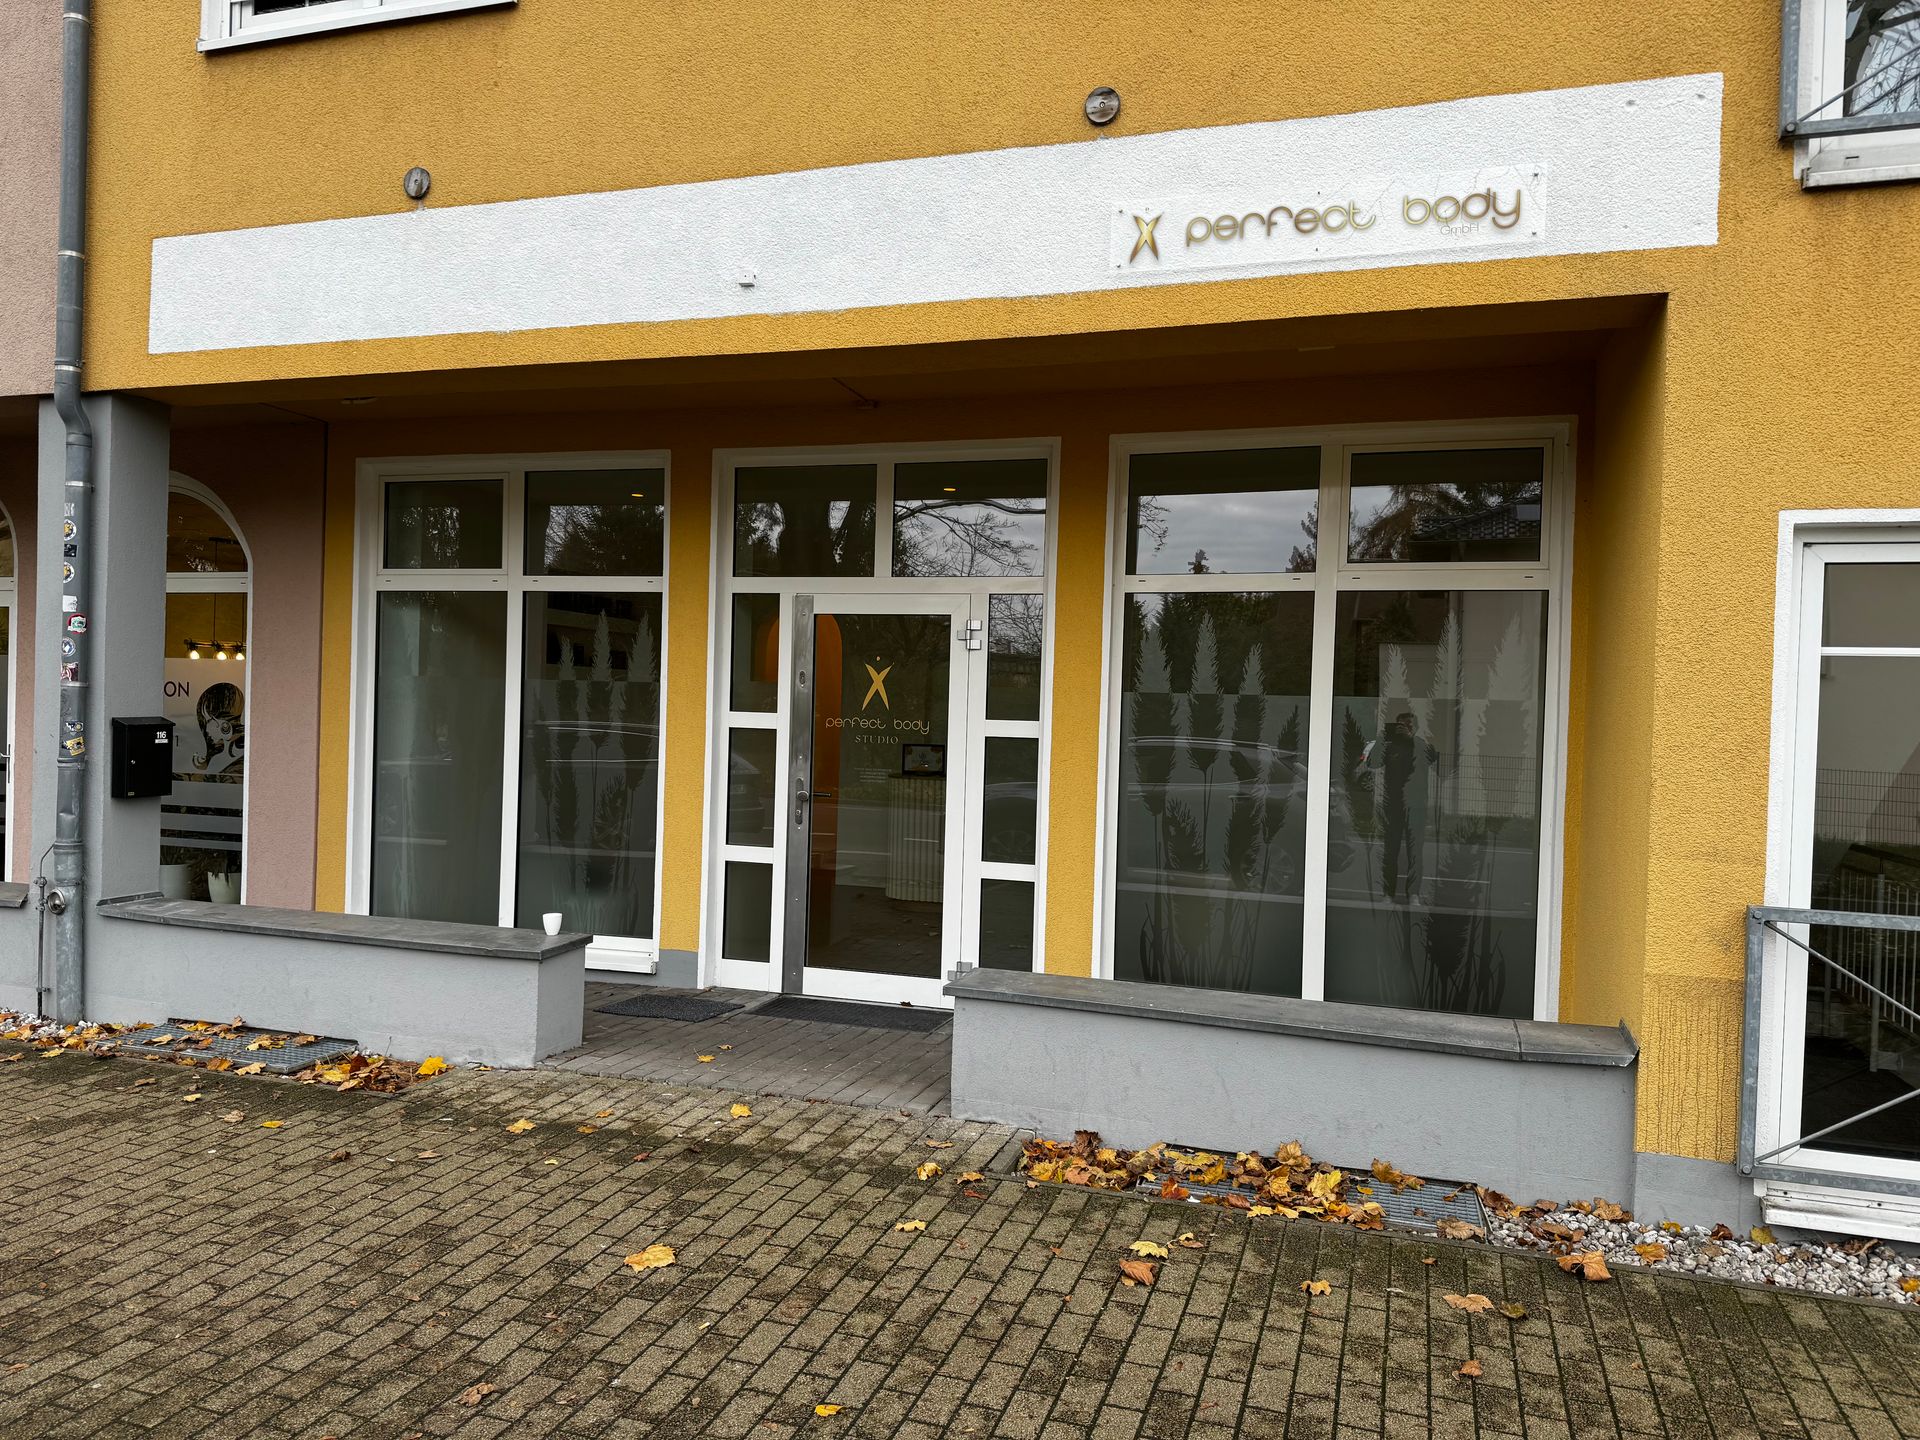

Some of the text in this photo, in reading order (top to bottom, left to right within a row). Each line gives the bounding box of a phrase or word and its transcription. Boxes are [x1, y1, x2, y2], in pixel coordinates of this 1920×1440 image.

[1187, 188, 1520, 247] perfect body
[1441, 223, 1479, 235] GmbH
[826, 717, 930, 734] perfect body
[156, 731, 167, 739] 116
[855, 735, 899, 744] STUDIO
